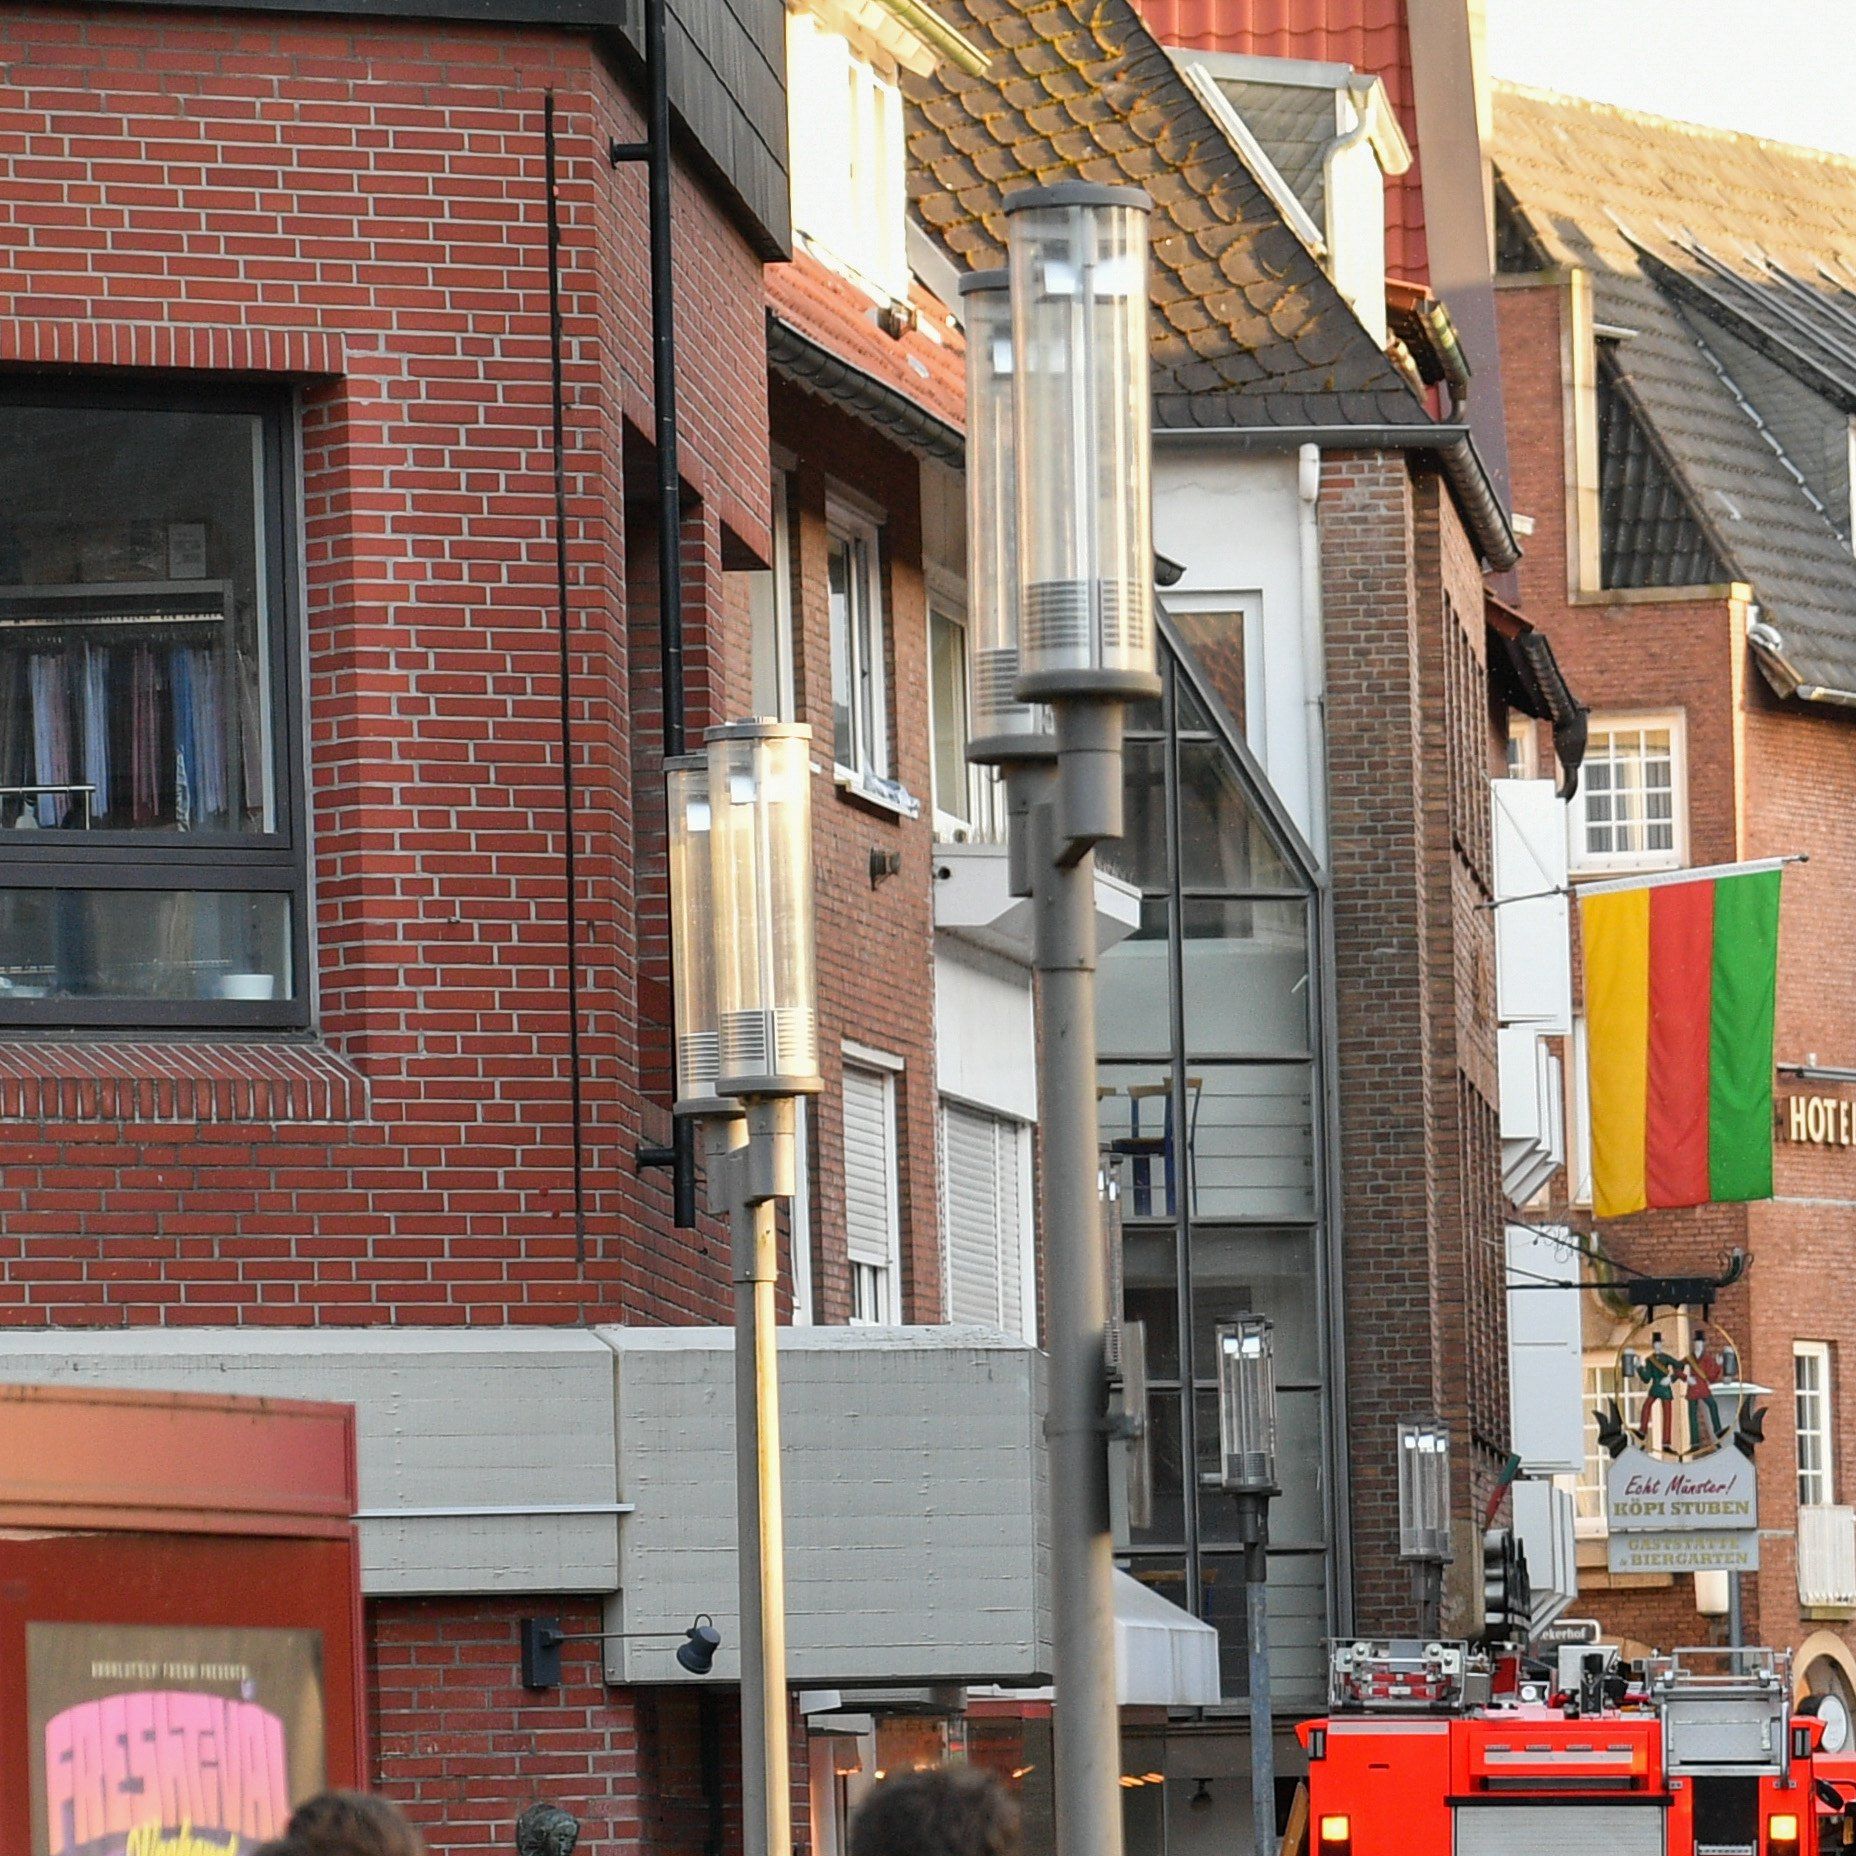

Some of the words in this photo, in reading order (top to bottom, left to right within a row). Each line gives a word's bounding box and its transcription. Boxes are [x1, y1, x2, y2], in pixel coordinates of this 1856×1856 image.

[1624, 1474, 1661, 1496] Echt
[1665, 1473, 1738, 1497] Münster!
[1613, 1497, 1666, 1516] KÖPI
[1670, 1500, 1750, 1516] STUBEN
[1631, 1552, 1749, 1567] BIERGARTEN
